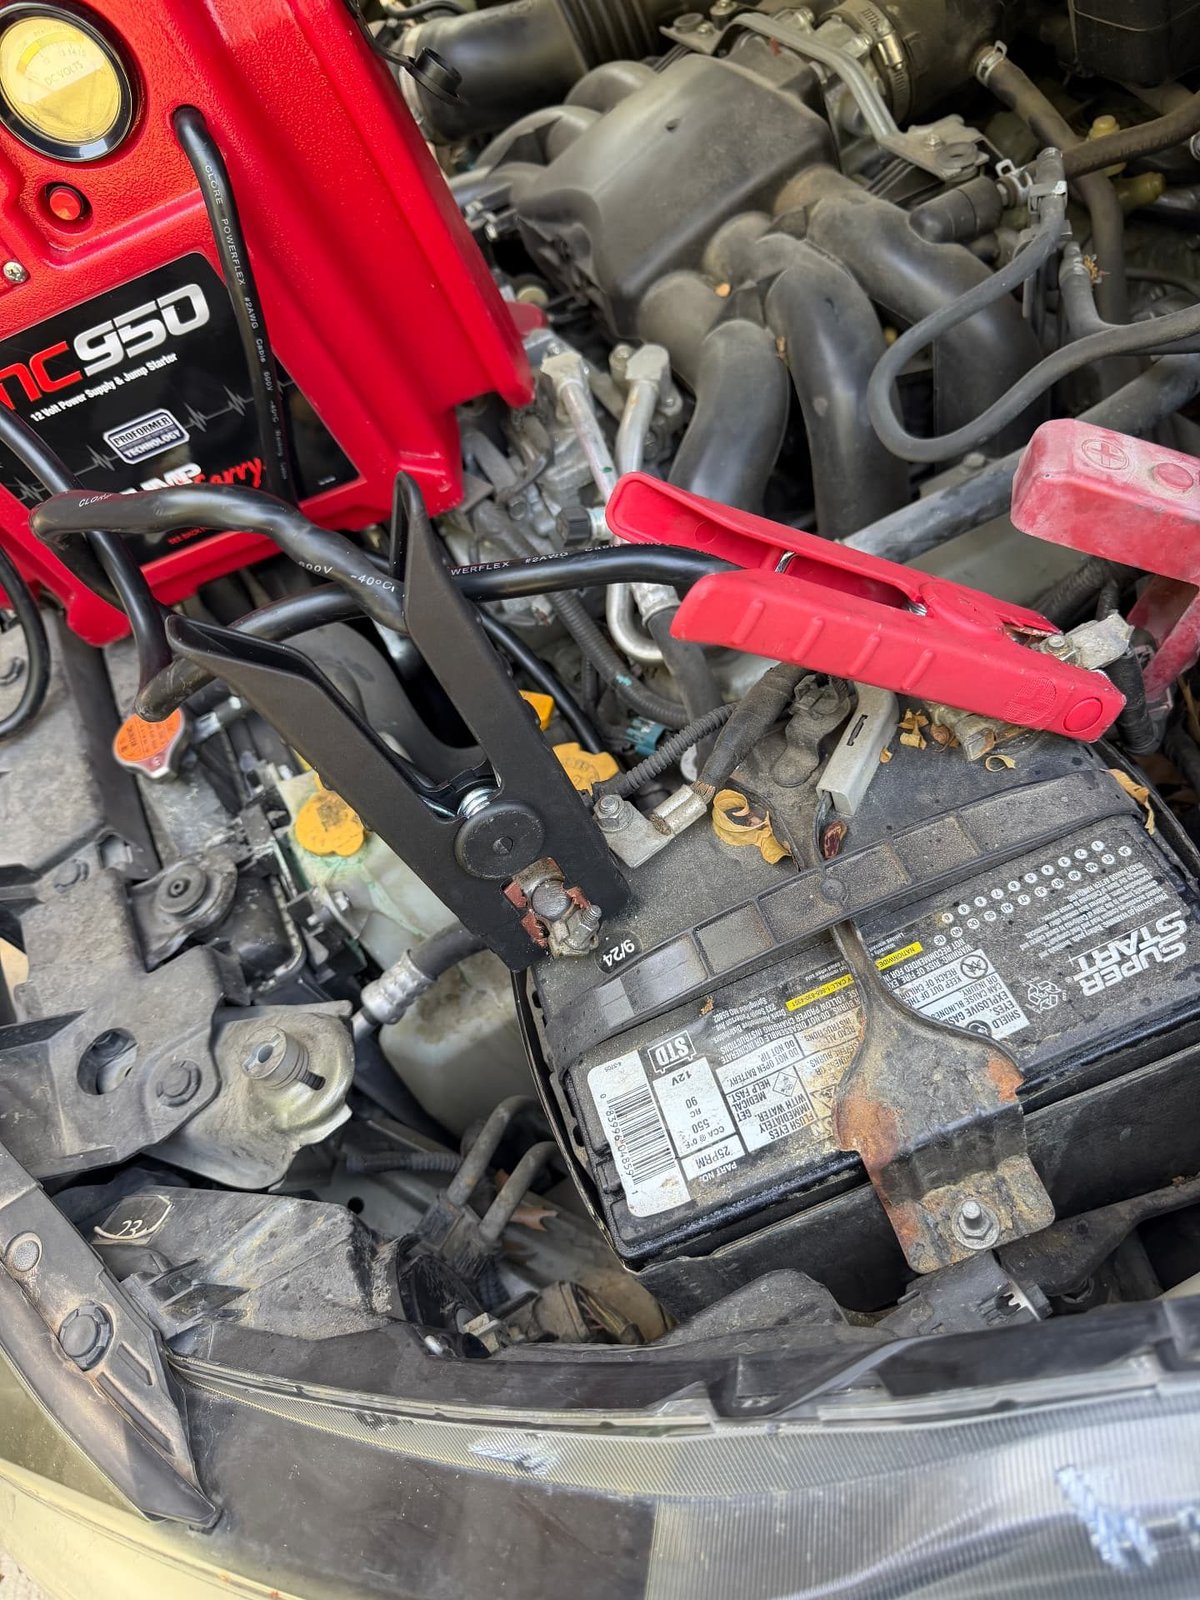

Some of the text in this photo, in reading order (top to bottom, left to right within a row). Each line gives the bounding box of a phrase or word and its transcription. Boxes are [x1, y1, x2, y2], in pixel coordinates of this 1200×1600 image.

[57, 59, 84, 78] VOLTS
[203, 164, 223, 205] CLORE
[221, 217, 246, 286] POWERFLEX
[243, 296, 258, 329] #2AWG
[30, 351, 178, 422] 12 Volt Power Supply & Jump Starter
[111, 416, 171, 446] PROFORMER
[123, 429, 182, 459] TECHNOLOGY
[450, 561, 510, 576] WERFLEX
[601, 937, 636, 967] 9/24
[949, 937, 965, 949] NOT
[1066, 909, 1189, 981] START
[878, 946, 915, 967] NATIONWIDE
[902, 944, 952, 972] RECOMMENDED
[938, 943, 973, 964] WARNING:
[889, 967, 904, 978] FOR
[913, 966, 925, 976] OF
[923, 958, 941, 972] RISK
[1077, 932, 1187, 998] SUPER
[830, 977, 847, 989] CALL
[922, 978, 935, 988] OF
[932, 967, 957, 984] REACH
[898, 983, 925, 1000] CHILDR
[904, 974, 962, 1007] KEEP OUT OF THE
[957, 974, 998, 997] OR INJURY.
[985, 981, 1002, 994] CAN
[737, 995, 767, 1013] Springfield
[818, 993, 845, 1011] FOLLOW
[963, 988, 988, 1005] CAUSE
[964, 989, 1008, 1017] EXPLOSIVE
[748, 1006, 765, 1018] South
[764, 1002, 776, 1012] 233
[793, 1004, 820, 1022] PROPER
[820, 1009, 830, 1019] DO
[829, 998, 855, 1014] BURNS.
[988, 999, 1015, 1017] EYES.
[724, 1012, 750, 1027] Patterson
[740, 1013, 771, 1030] Automotive
[761, 1016, 795, 1034] CHARGING
[805, 1013, 821, 1026] NOT
[990, 1008, 1021, 1029] SHIELD
[762, 1019, 808, 1042] DISASSEMBLE
[824, 1023, 856, 1044] READ ALL
[716, 1026, 763, 1056] INSTRUCTIONS.
[753, 1035, 764, 1046] OR
[784, 1038, 795, 1050] DO
[651, 1035, 690, 1067] STD
[717, 1040, 755, 1064] INCINERATE.
[769, 1043, 785, 1057] NOT
[725, 1046, 799, 1088] DO NOT OPEN BATTERY.
[669, 1069, 692, 1086] 12V
[727, 1077, 771, 1104] HELP FAST.
[683, 1095, 698, 1109] 90
[731, 1090, 767, 1114] MEDICAL
[754, 1092, 806, 1124] WITH WATER.
[688, 1107, 701, 1118] RC
[734, 1107, 752, 1122] GET
[757, 1101, 810, 1133] IMMEDIATELY
[788, 1111, 815, 1130] FLUSH
[690, 1117, 710, 1134] 550
[706, 1124, 725, 1138] CCA
[767, 1123, 789, 1140] EYES
[604, 1108, 621, 1142] 83996
[616, 1143, 633, 1177] 04859
[694, 1144, 731, 1169] 25PRM
[698, 1159, 737, 1183] PART NO.
